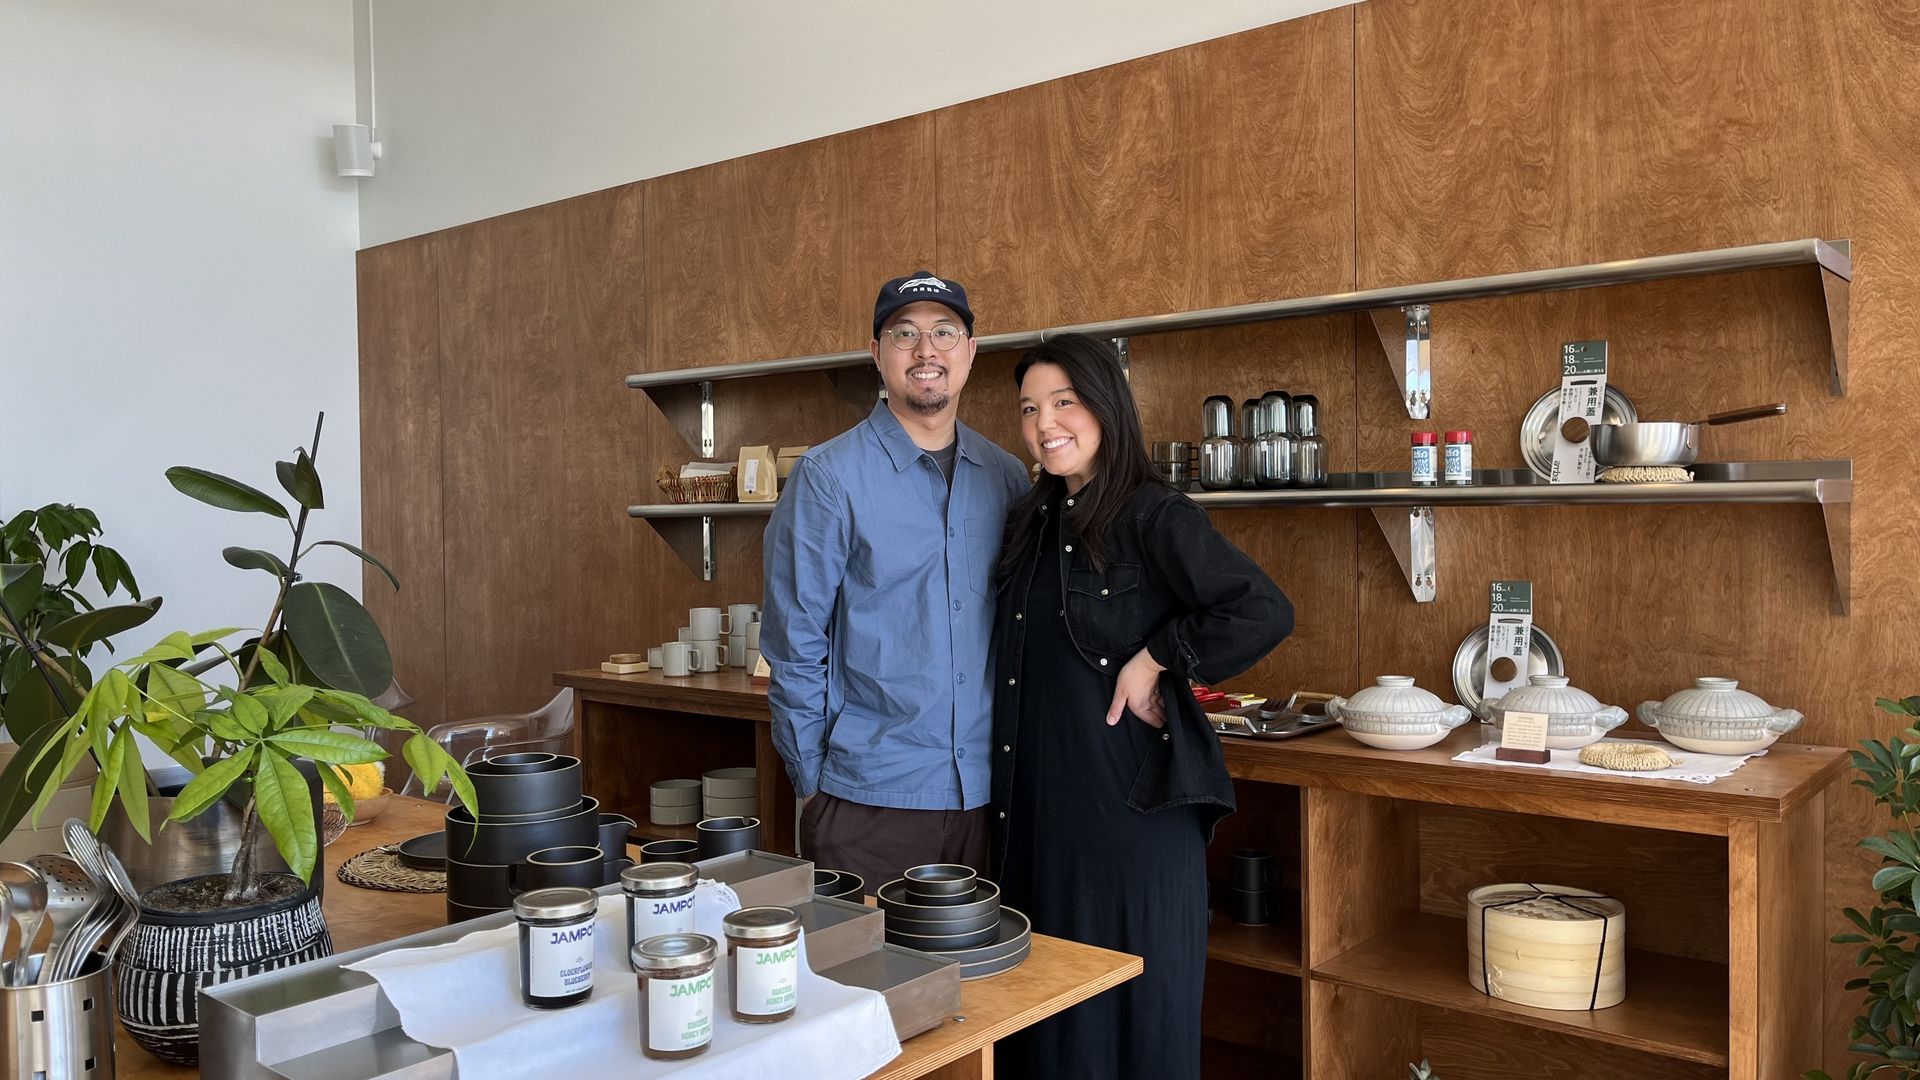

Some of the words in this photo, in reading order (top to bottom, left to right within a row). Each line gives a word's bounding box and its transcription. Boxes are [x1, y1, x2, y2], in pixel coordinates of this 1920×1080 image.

[1512, 625, 1525, 656] 兼用蓋
[756, 945, 797, 965] JAMPO
[670, 975, 712, 997] JAMPO
